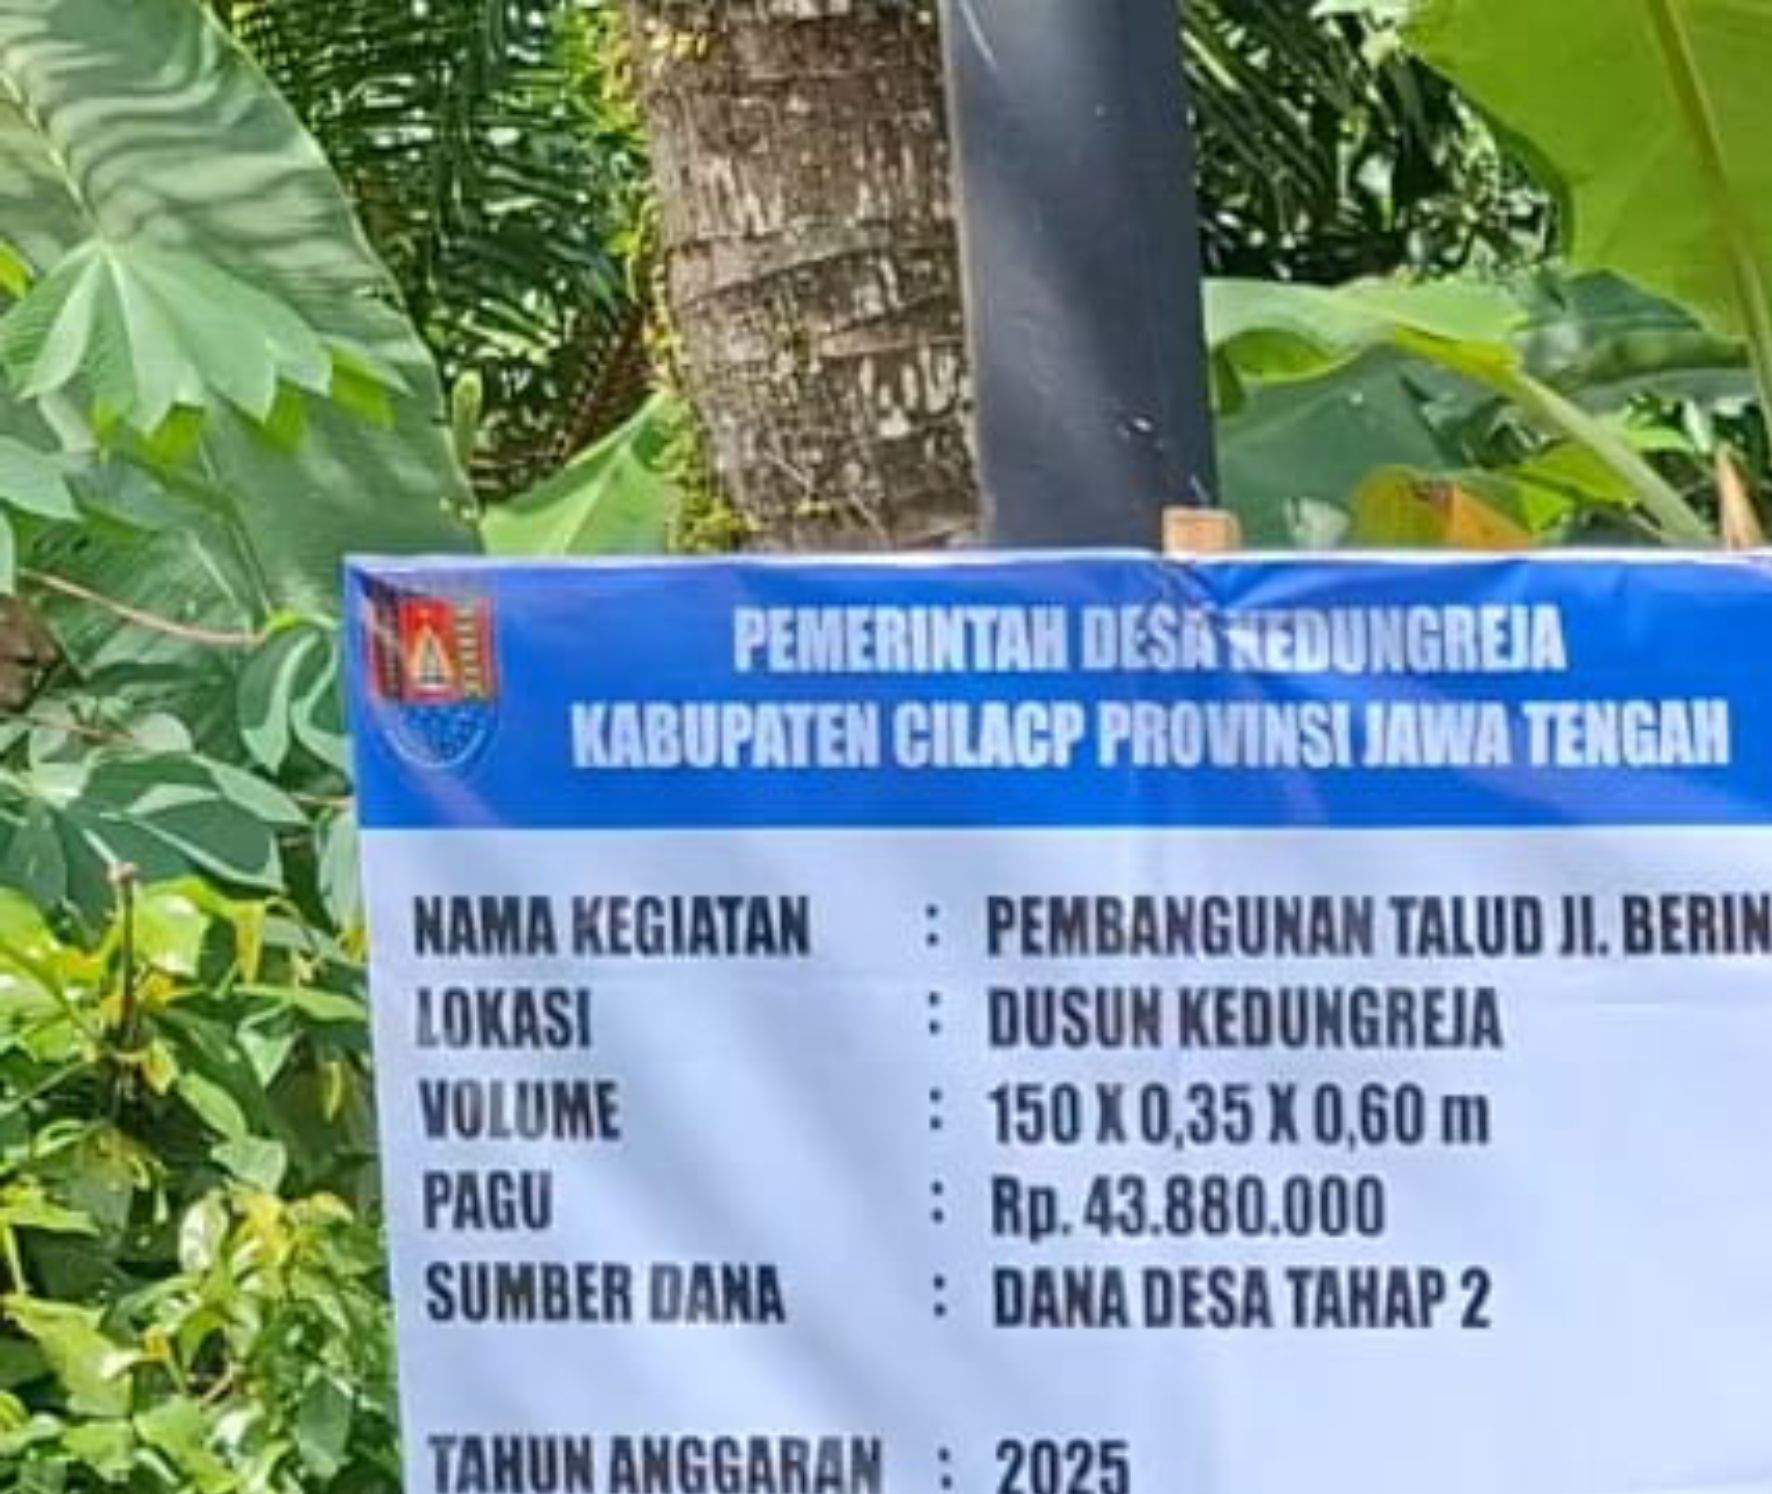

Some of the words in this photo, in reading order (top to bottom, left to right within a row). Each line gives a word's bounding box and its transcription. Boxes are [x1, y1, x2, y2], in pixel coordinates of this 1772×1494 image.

[733, 605, 1068, 673] PEMERINTAH
[1081, 601, 1220, 672] DESA
[1229, 603, 1567, 675] KEDUNGREJA
[571, 701, 881, 768] KABUPATEN
[893, 701, 1085, 768] CILACP
[1098, 699, 1352, 769] PROVINSI
[1363, 700, 1510, 767] JAWA
[1522, 699, 1730, 770] TENGAH
[414, 895, 558, 956] NAMA
[572, 895, 810, 956] KEGIATAN
[925, 903, 940, 947] :
[986, 895, 1374, 958] PEMBANGUNAN
[1388, 895, 1543, 958] TALUD
[418, 987, 592, 1050] LOKASI
[927, 990, 941, 1035] :
[988, 986, 1162, 1049] DUSUN
[1178, 986, 1503, 1050] KEDUNGREJA
[418, 1078, 621, 1141] VOLUME
[929, 1088, 943, 1131] :
[989, 1082, 1081, 1145] 150
[1095, 1082, 1127, 1144] X
[1140, 1082, 1254, 1149] 0,35
[1268, 1082, 1299, 1144] X
[1314, 1082, 1425, 1149] 0,60
[1441, 1094, 1489, 1145] m
[423, 1170, 552, 1231] PAGU
[930, 1180, 945, 1224] :
[991, 1175, 1071, 1243] Rp.
[1083, 1174, 1385, 1237] 43.880.000
[425, 1261, 632, 1323] SUMBER
[650, 1262, 787, 1324] DANA
[932, 1274, 947, 1318] :
[992, 1266, 1129, 1329] DANA
[1142, 1266, 1273, 1329] DESA
[1285, 1266, 1446, 1329] TAHAP
[1460, 1266, 1491, 1329] 2
[428, 1435, 594, 1494] TAHUN
[937, 1447, 953, 1490] :
